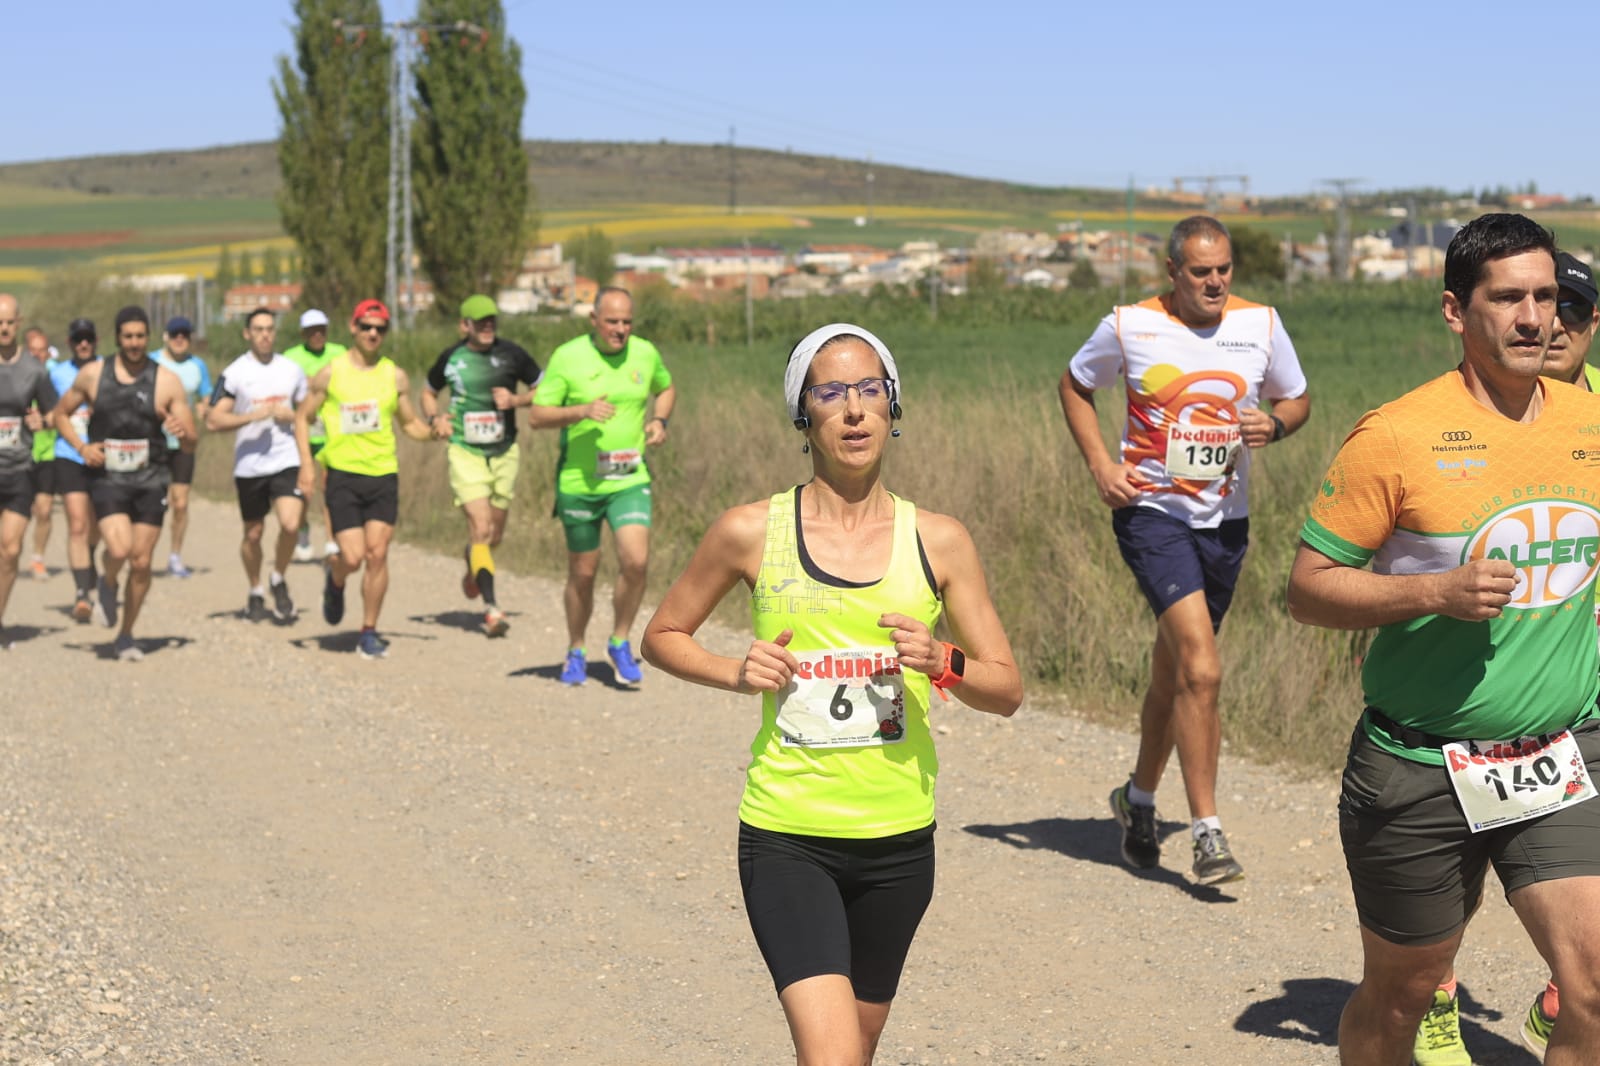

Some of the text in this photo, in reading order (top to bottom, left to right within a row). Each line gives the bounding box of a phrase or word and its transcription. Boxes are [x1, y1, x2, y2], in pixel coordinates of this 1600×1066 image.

[1186, 445, 1228, 466] 130
[1431, 443, 1488, 452] Helmántica
[1460, 483, 1600, 531] CLUB DEPORTI
[798, 652, 903, 680] edunia
[829, 683, 854, 721] 6
[1484, 755, 1562, 802] 140
